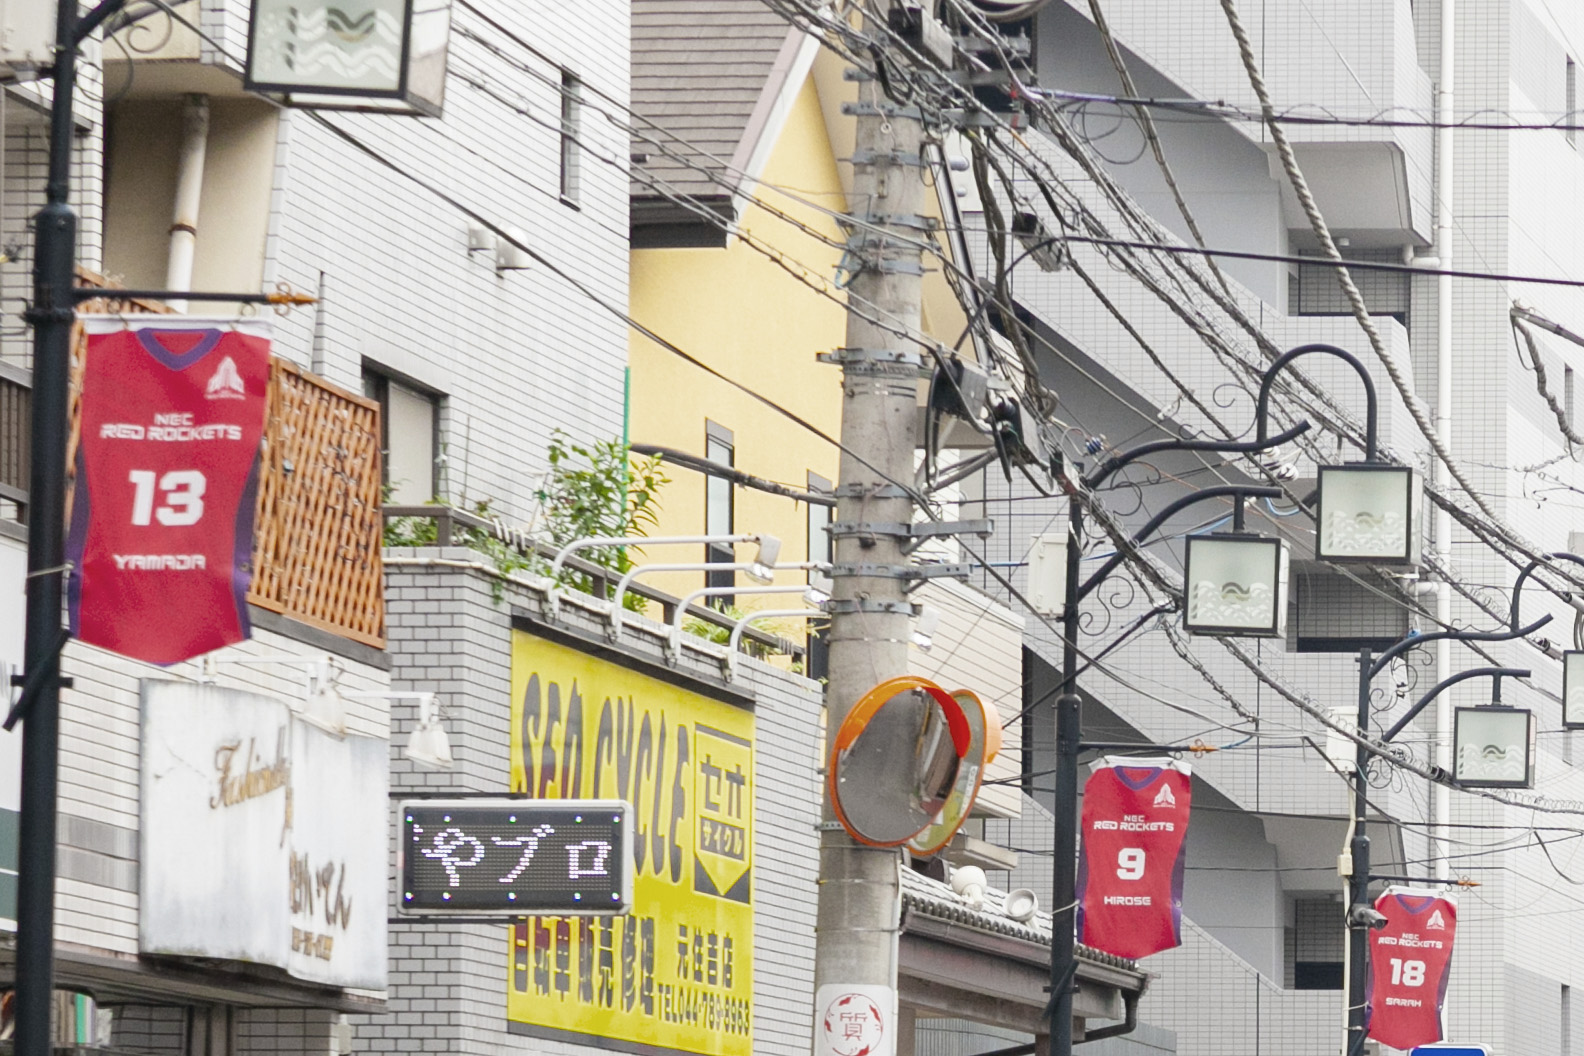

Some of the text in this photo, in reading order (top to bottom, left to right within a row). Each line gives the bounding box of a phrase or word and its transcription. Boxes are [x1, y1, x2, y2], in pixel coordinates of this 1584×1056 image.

[154, 412, 195, 426] NEC
[101, 424, 242, 441] RED ROCKETS
[129, 469, 206, 527] 13
[114, 553, 206, 571] YAMADA
[700, 753, 746, 820] セオ
[1094, 821, 1174, 832] RED ROCKETS
[1124, 814, 1145, 822] NEC
[1116, 848, 1146, 880] 9
[1104, 896, 1152, 905] HIROSE
[1378, 937, 1443, 949] RED ROCKETS
[1390, 958, 1426, 987] 18
[1385, 997, 1421, 1007] SARAH
[839, 1012, 868, 1041] 質
